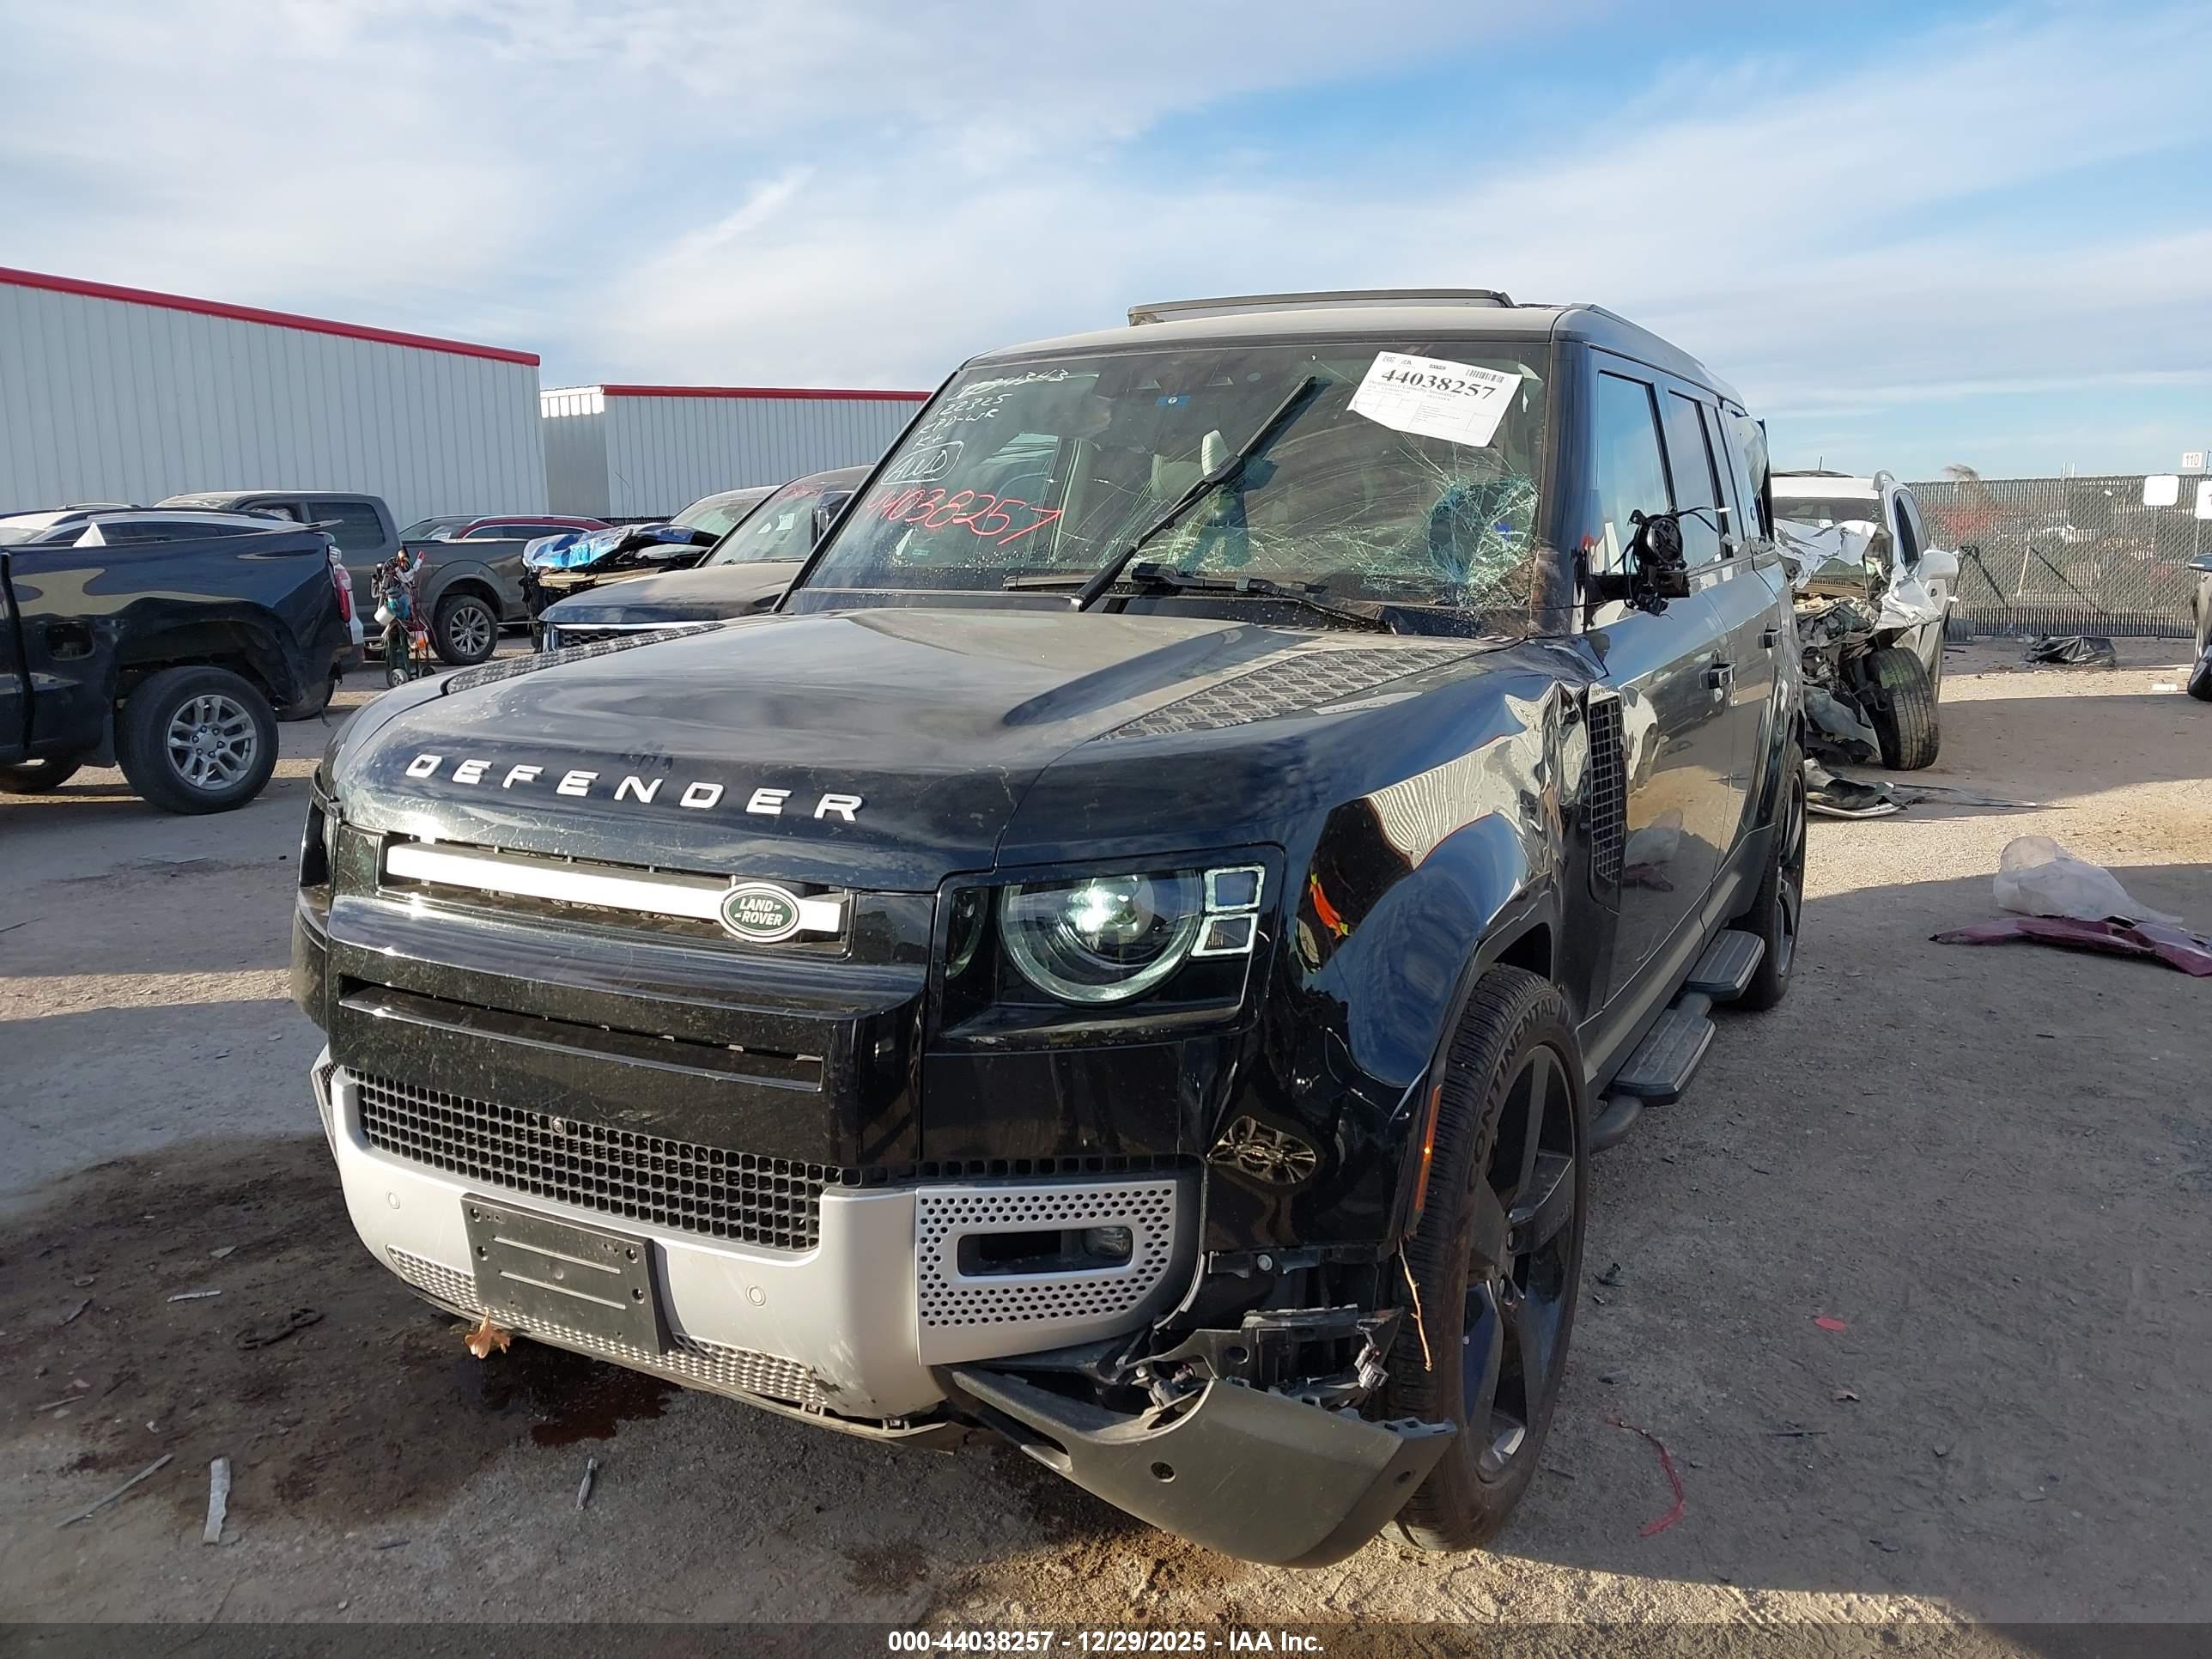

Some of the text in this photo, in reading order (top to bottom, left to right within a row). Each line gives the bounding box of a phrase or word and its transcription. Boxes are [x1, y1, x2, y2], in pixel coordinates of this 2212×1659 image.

[1382, 368, 1496, 400] 44038257
[404, 753, 864, 822] DEFENDER
[738, 897, 775, 913] LAND
[741, 910, 784, 927] ROVER
[1468, 997, 1556, 1195] CONTINENTAL
